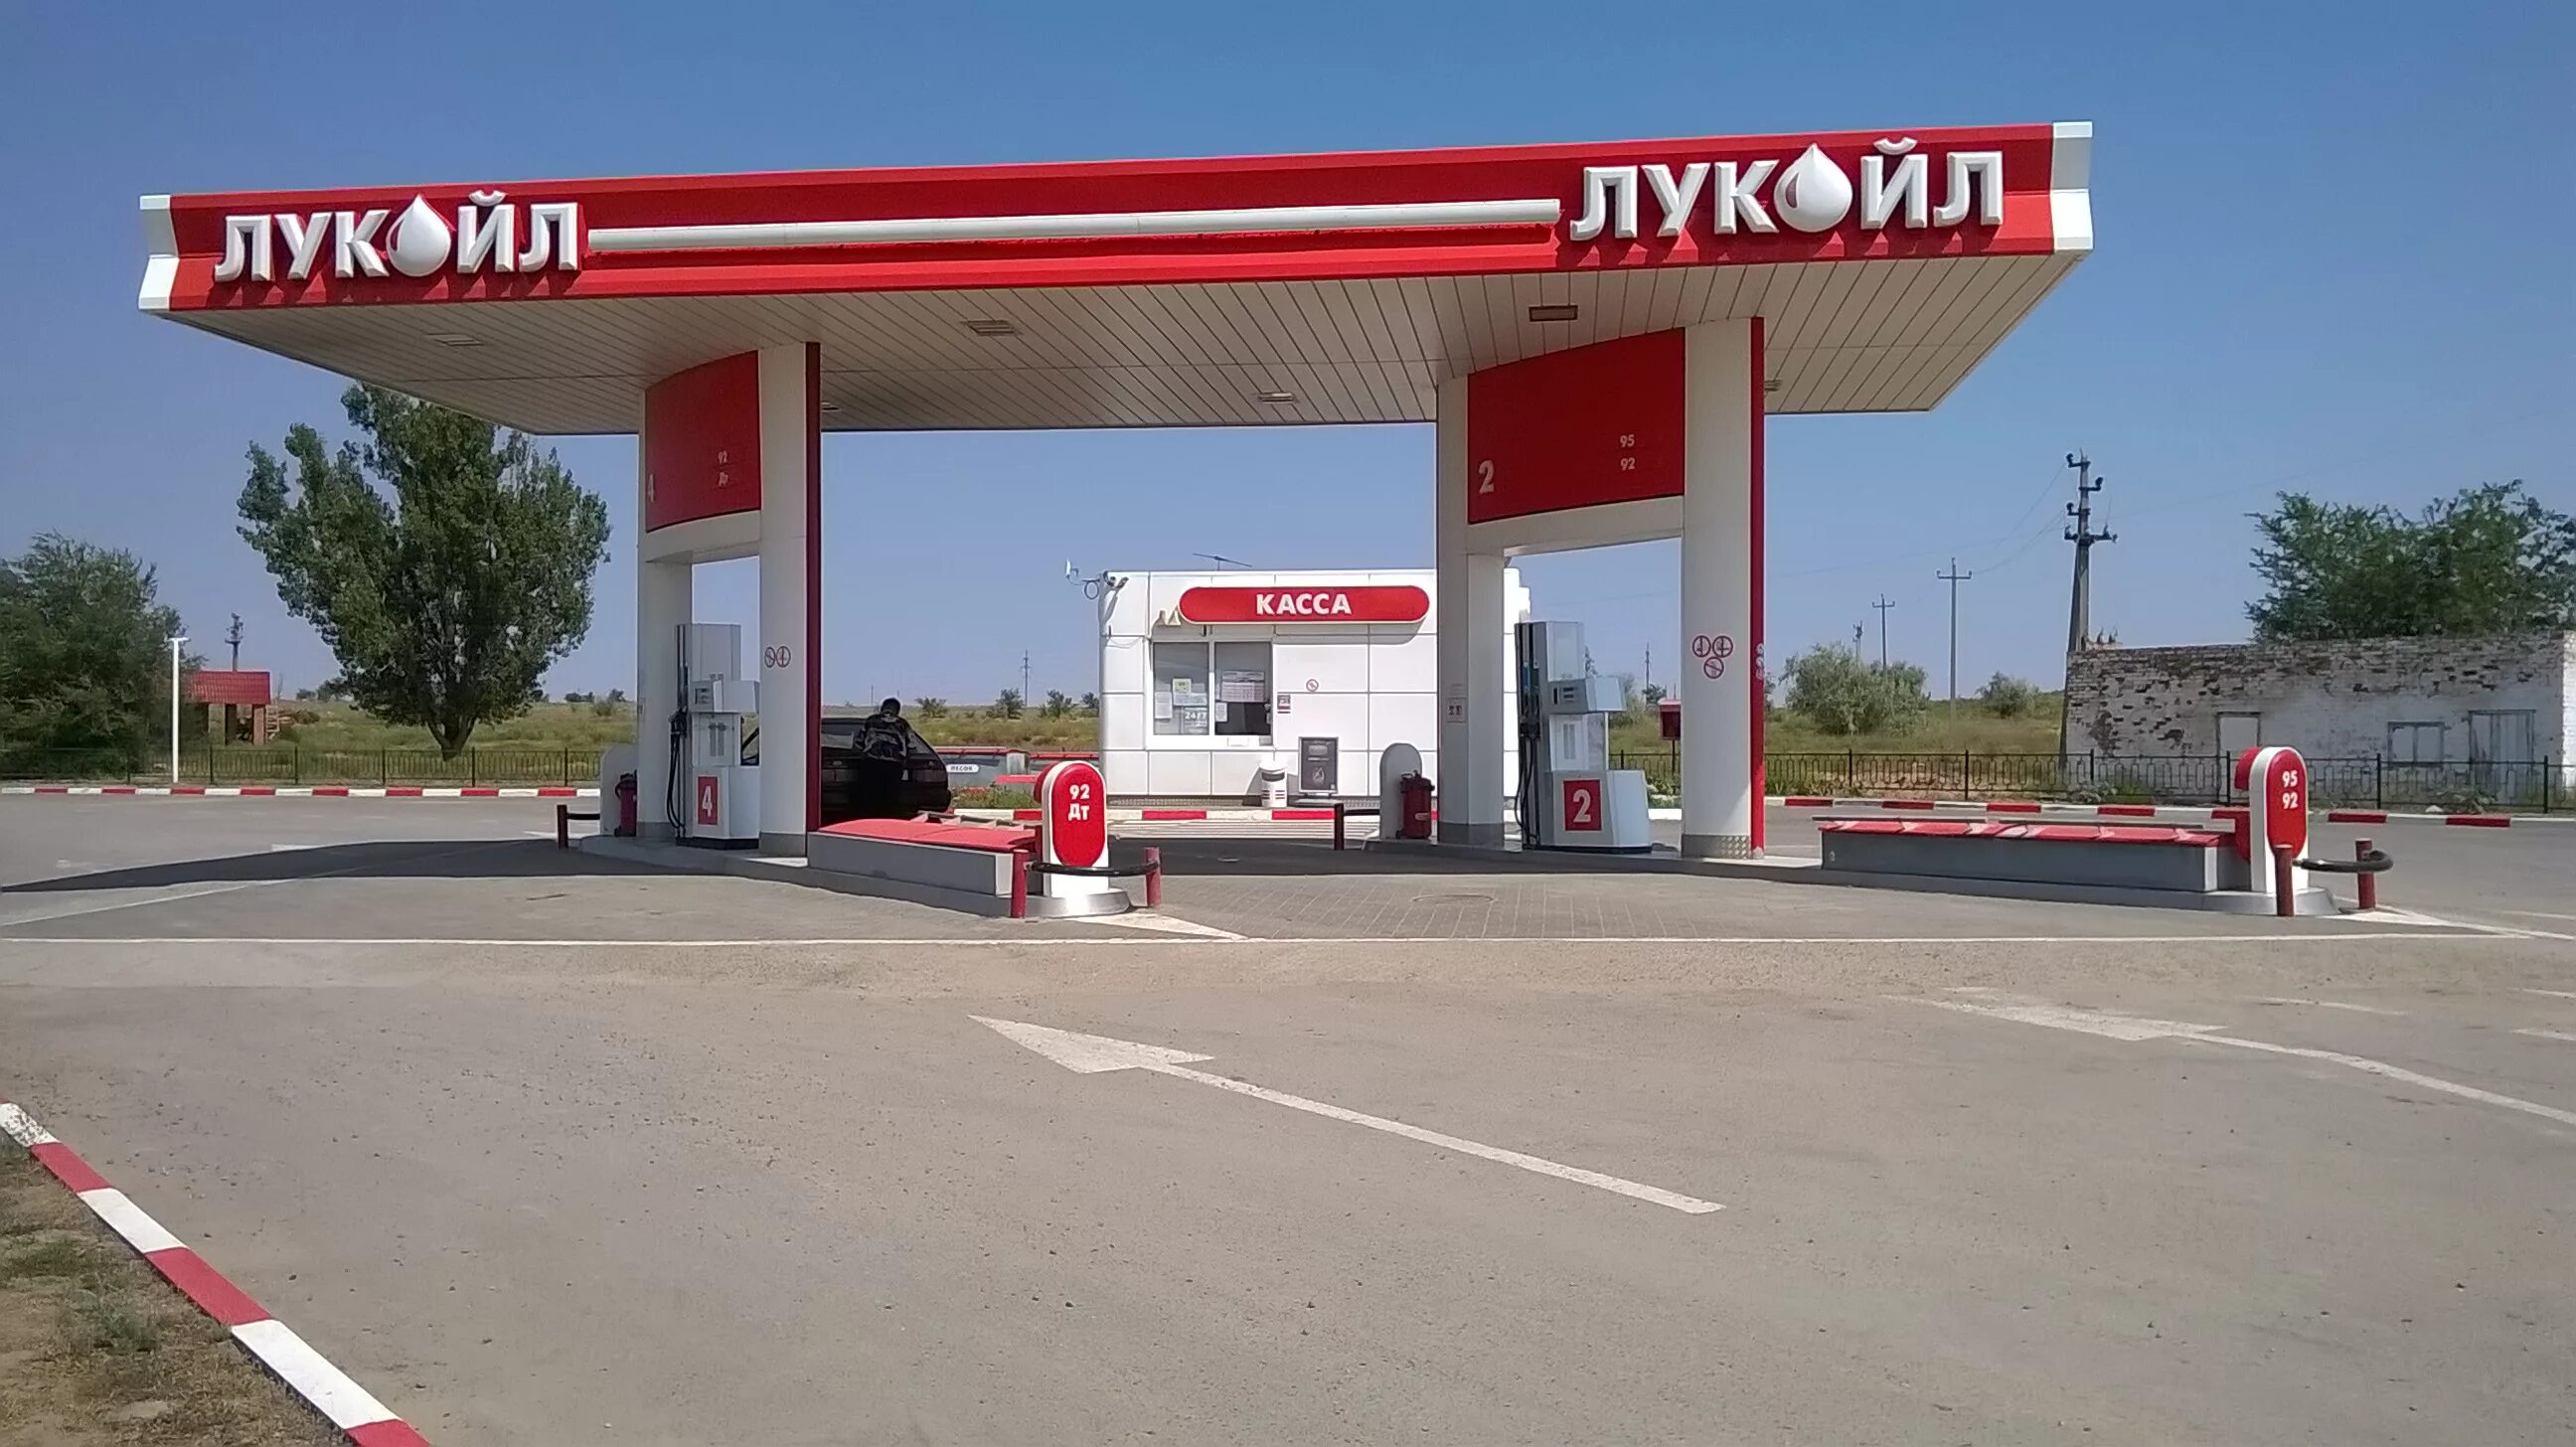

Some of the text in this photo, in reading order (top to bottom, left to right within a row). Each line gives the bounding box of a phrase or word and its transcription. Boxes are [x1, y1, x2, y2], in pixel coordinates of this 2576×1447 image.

[1569, 136, 2005, 241] ЛУКОЙЛ
[214, 189, 579, 282] ЛУКОЙЛ
[1620, 434, 1635, 447] 95
[718, 450, 727, 464] 92
[1620, 457, 1636, 471] 92
[1478, 460, 1495, 494] 2
[1255, 592, 1353, 615] КАССА
[2282, 770, 2298, 788] 95
[702, 786, 713, 817] 4
[1069, 783, 1090, 800] 92
[2282, 792, 2299, 810] 92
[1572, 789, 1591, 823] 2
